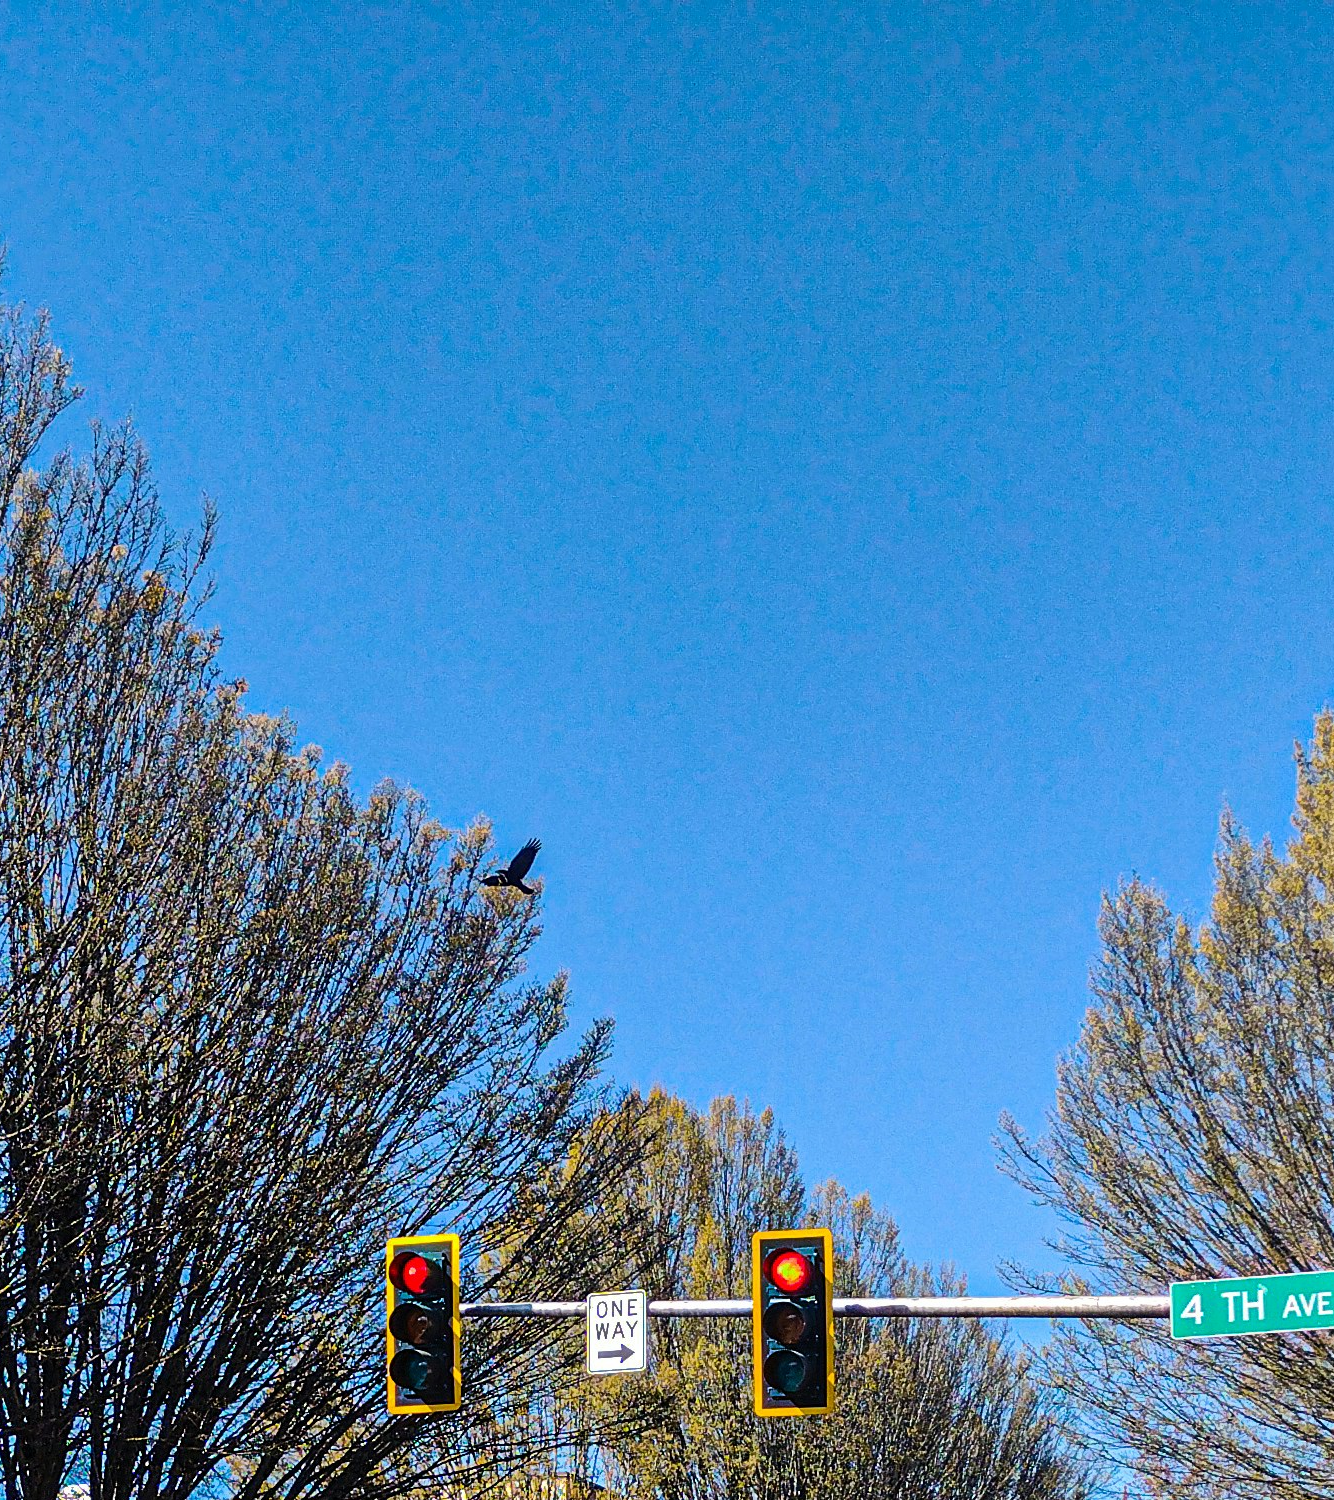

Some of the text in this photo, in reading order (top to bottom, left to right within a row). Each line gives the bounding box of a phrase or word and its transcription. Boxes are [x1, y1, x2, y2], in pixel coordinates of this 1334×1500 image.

[596, 1298, 638, 1319] ONE
[1180, 1289, 1334, 1325] 4 TH AVE
[596, 1320, 638, 1340] WAY
